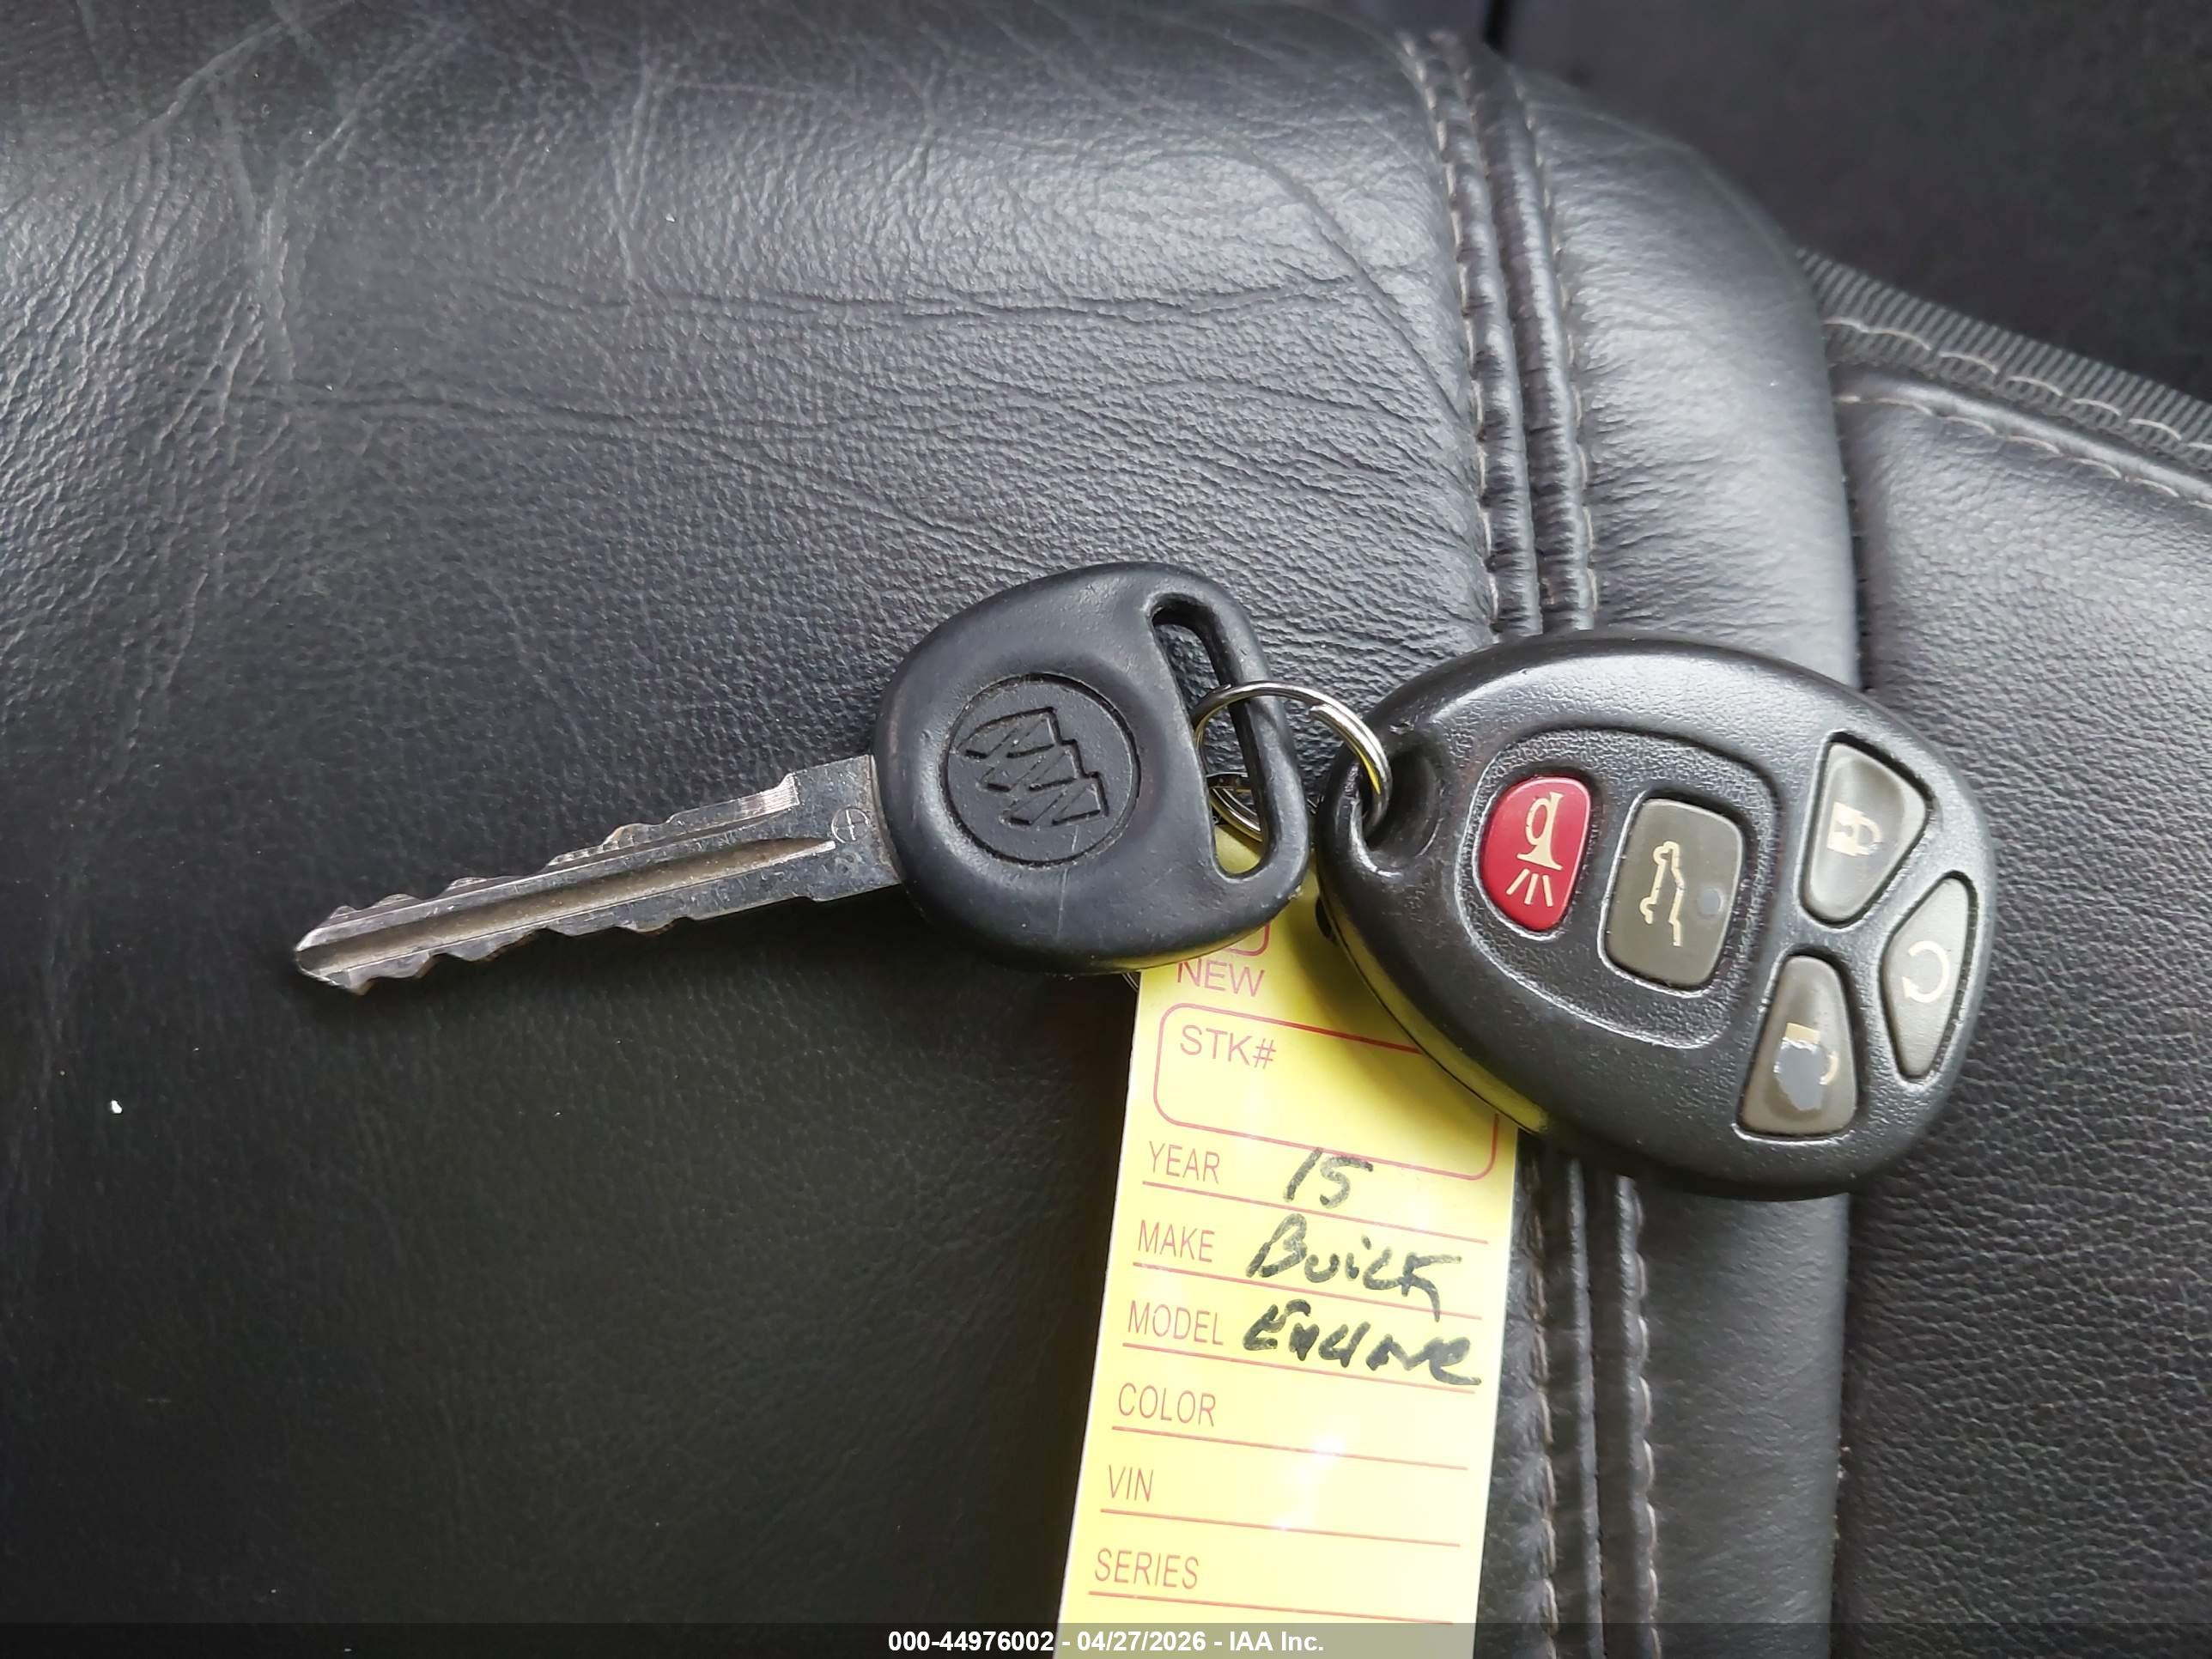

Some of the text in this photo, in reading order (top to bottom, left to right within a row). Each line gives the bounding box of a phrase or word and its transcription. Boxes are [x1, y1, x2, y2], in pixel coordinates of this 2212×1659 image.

[1176, 958, 1266, 997] NEW
[1180, 1024, 1277, 1070] STK#
[1148, 1140, 1221, 1185] YEAR
[1282, 1147, 1375, 1209] 15
[1138, 1218, 1216, 1263] MAKE
[1245, 1212, 1462, 1322] Buick
[1127, 1299, 1224, 1346] MODEL
[1117, 1382, 1217, 1427] COLOR
[1108, 1463, 1154, 1503] VIN
[1093, 1547, 1200, 1590] SERIES
